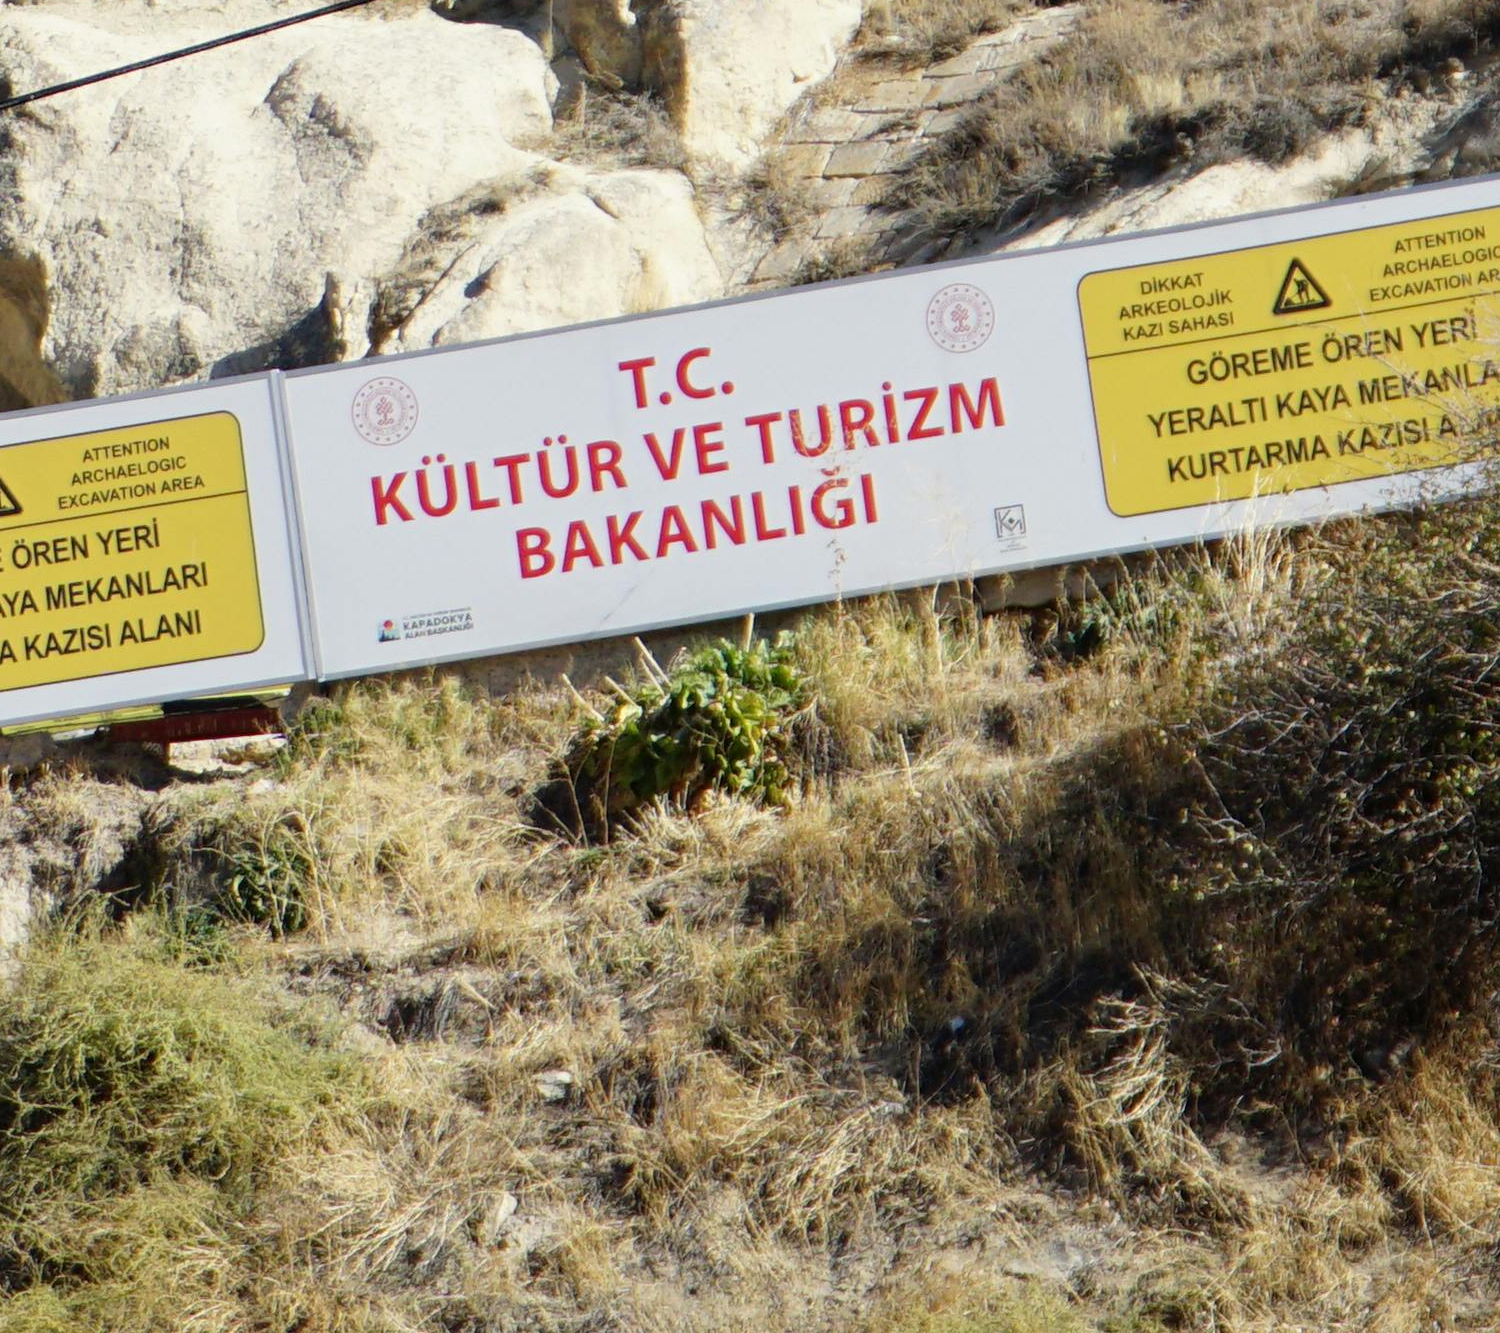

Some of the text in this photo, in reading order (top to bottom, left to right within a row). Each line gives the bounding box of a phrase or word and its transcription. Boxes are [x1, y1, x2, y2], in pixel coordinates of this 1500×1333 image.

[1394, 226, 1485, 253] ATTENTION
[1119, 289, 1232, 321] ARKEOLOJİK
[1140, 272, 1203, 295] DİKKAT
[1369, 274, 1472, 302] EXCAVATION
[1123, 311, 1233, 342] KAZI SAHASI
[618, 348, 734, 408] T.C.
[1187, 341, 1313, 385] GÖREME
[1322, 327, 1403, 363] ÖREN
[1147, 397, 1267, 438] YERALTI
[1275, 384, 1351, 418] KAYA
[71, 456, 185, 485] ARCHAELOGIC
[83, 437, 169, 462] ATTENTION
[372, 378, 1005, 526] KÜLTÜR VE TURİZM
[1167, 435, 1330, 483] KURTARMA
[1336, 418, 1428, 456] KAZISI
[58, 475, 204, 509] EXCAVATION AREA
[12, 534, 89, 569] ÖREN
[95, 518, 159, 555] YERİ
[516, 467, 877, 578] BAKANLIĞI
[45, 562, 207, 610] MEKANLARI
[24, 624, 111, 660] KAZISI
[119, 610, 201, 646] ALANI
